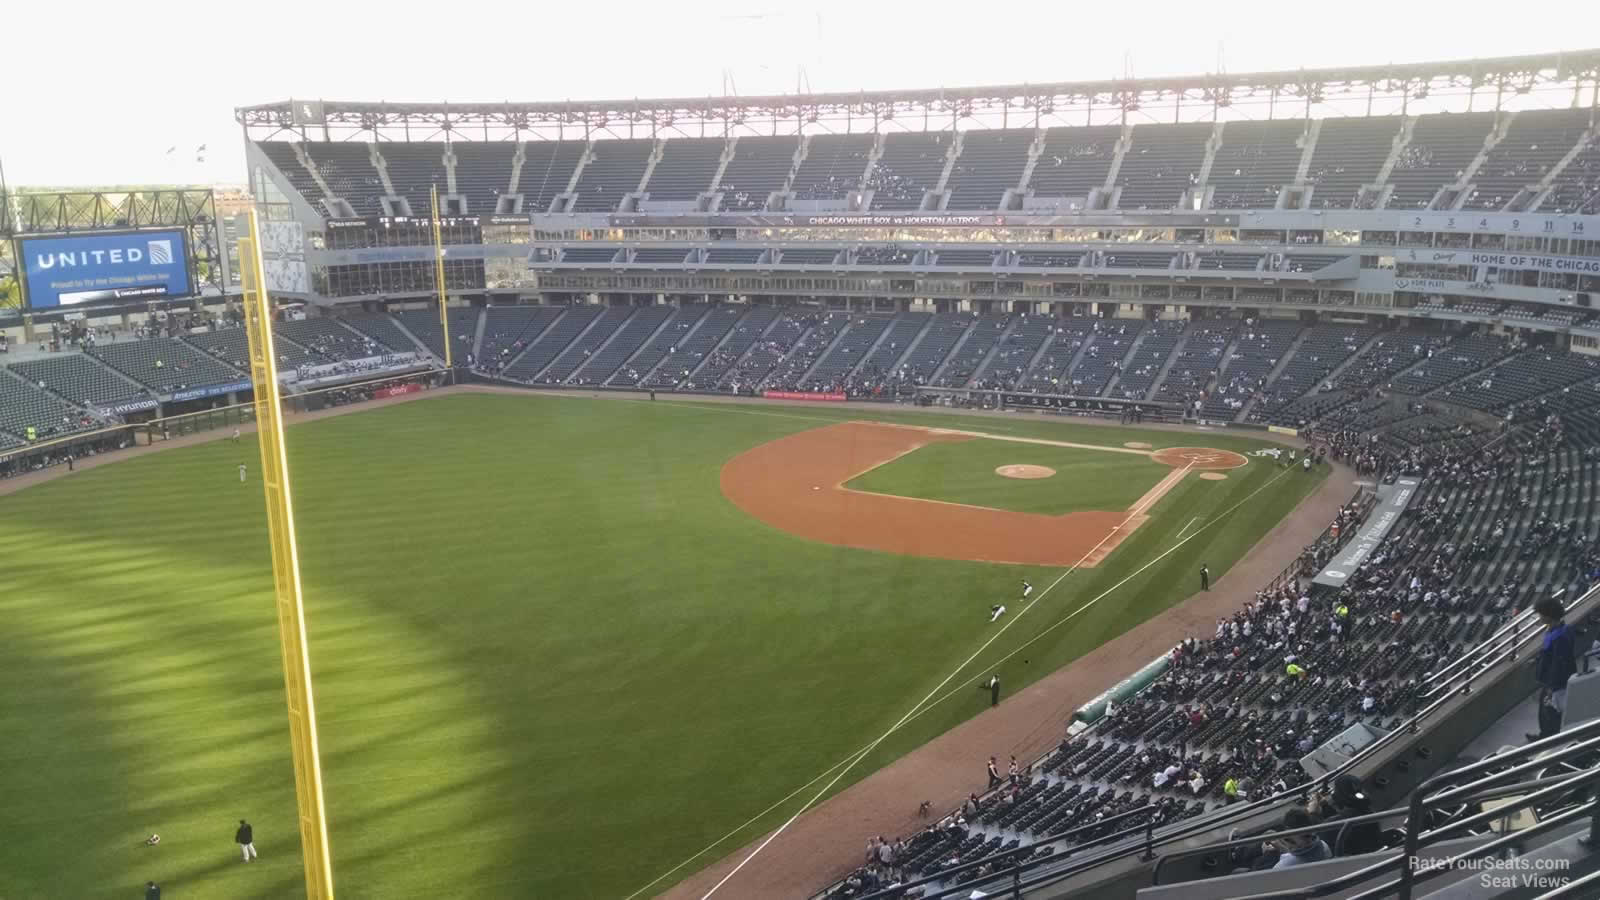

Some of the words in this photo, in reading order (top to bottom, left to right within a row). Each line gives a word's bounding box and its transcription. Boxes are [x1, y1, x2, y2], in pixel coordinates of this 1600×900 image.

[809, 216, 845, 225] CHICAGO
[846, 216, 873, 225] WHITE
[874, 216, 890, 225] SOX
[904, 216, 946, 225] HOUSTON
[947, 216, 980, 225] ASTROS
[1415, 217, 1422, 226] 2
[1480, 219, 1487, 228] 4
[1512, 219, 1520, 229] 9
[1572, 221, 1584, 232] 14
[38, 248, 143, 268] UNITED
[1472, 254, 1506, 265] HOME
[1510, 256, 1526, 266] OF
[1530, 257, 1553, 268] THE
[115, 400, 159, 413] HYUNDAI
